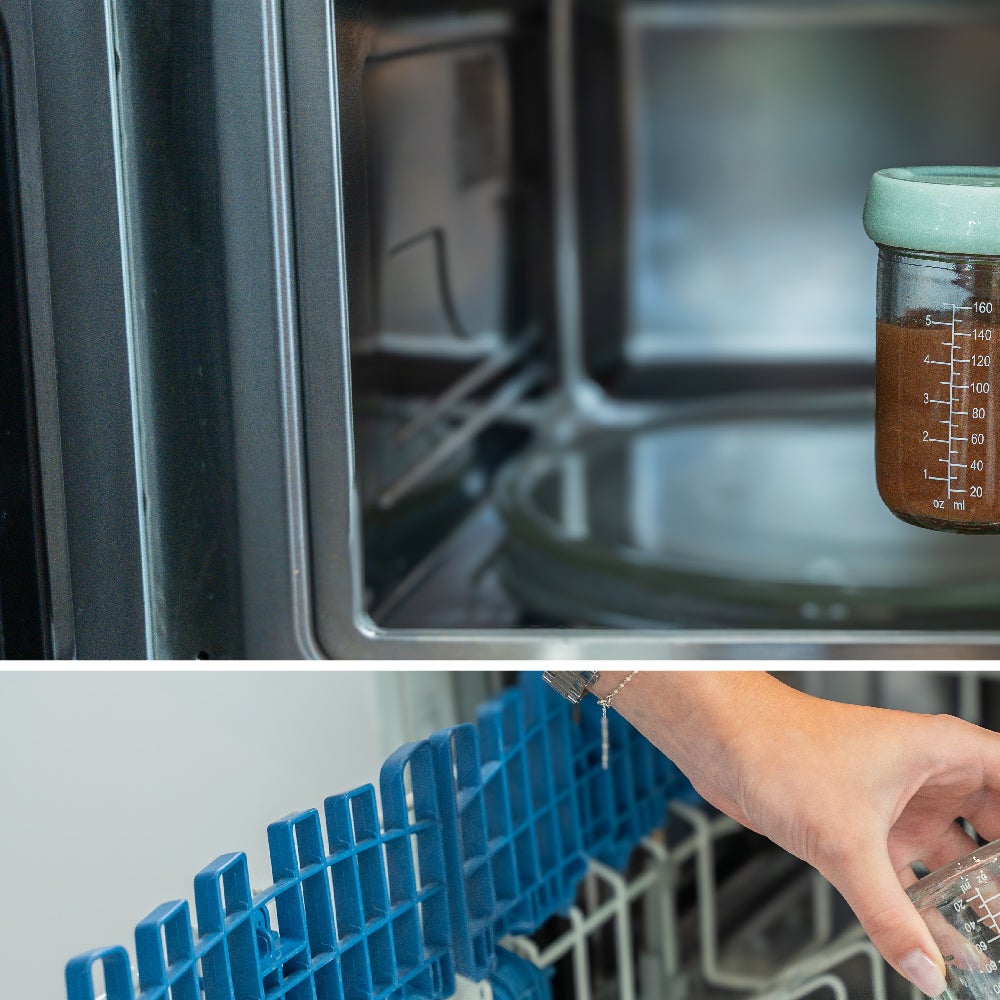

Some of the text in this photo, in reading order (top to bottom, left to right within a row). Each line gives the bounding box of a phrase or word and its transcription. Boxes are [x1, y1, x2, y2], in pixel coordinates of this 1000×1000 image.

[973, 302, 993, 314] 160
[925, 315, 932, 325] 5
[972, 329, 992, 341] 140
[924, 355, 930, 364] 4
[971, 355, 991, 367] 120
[970, 382, 990, 394] 100
[923, 393, 929, 404] 3
[972, 408, 985, 419] 80
[922, 432, 929, 442] 2
[971, 433, 985, 445] 60
[970, 460, 984, 471] 40
[923, 469, 928, 479] 1
[970, 486, 983, 498] 20
[933, 499, 965, 510] oz ml
[953, 899, 966, 912] 20
[964, 921, 976, 932] 40
[976, 941, 987, 953] 60
[985, 960, 998, 974] 80
